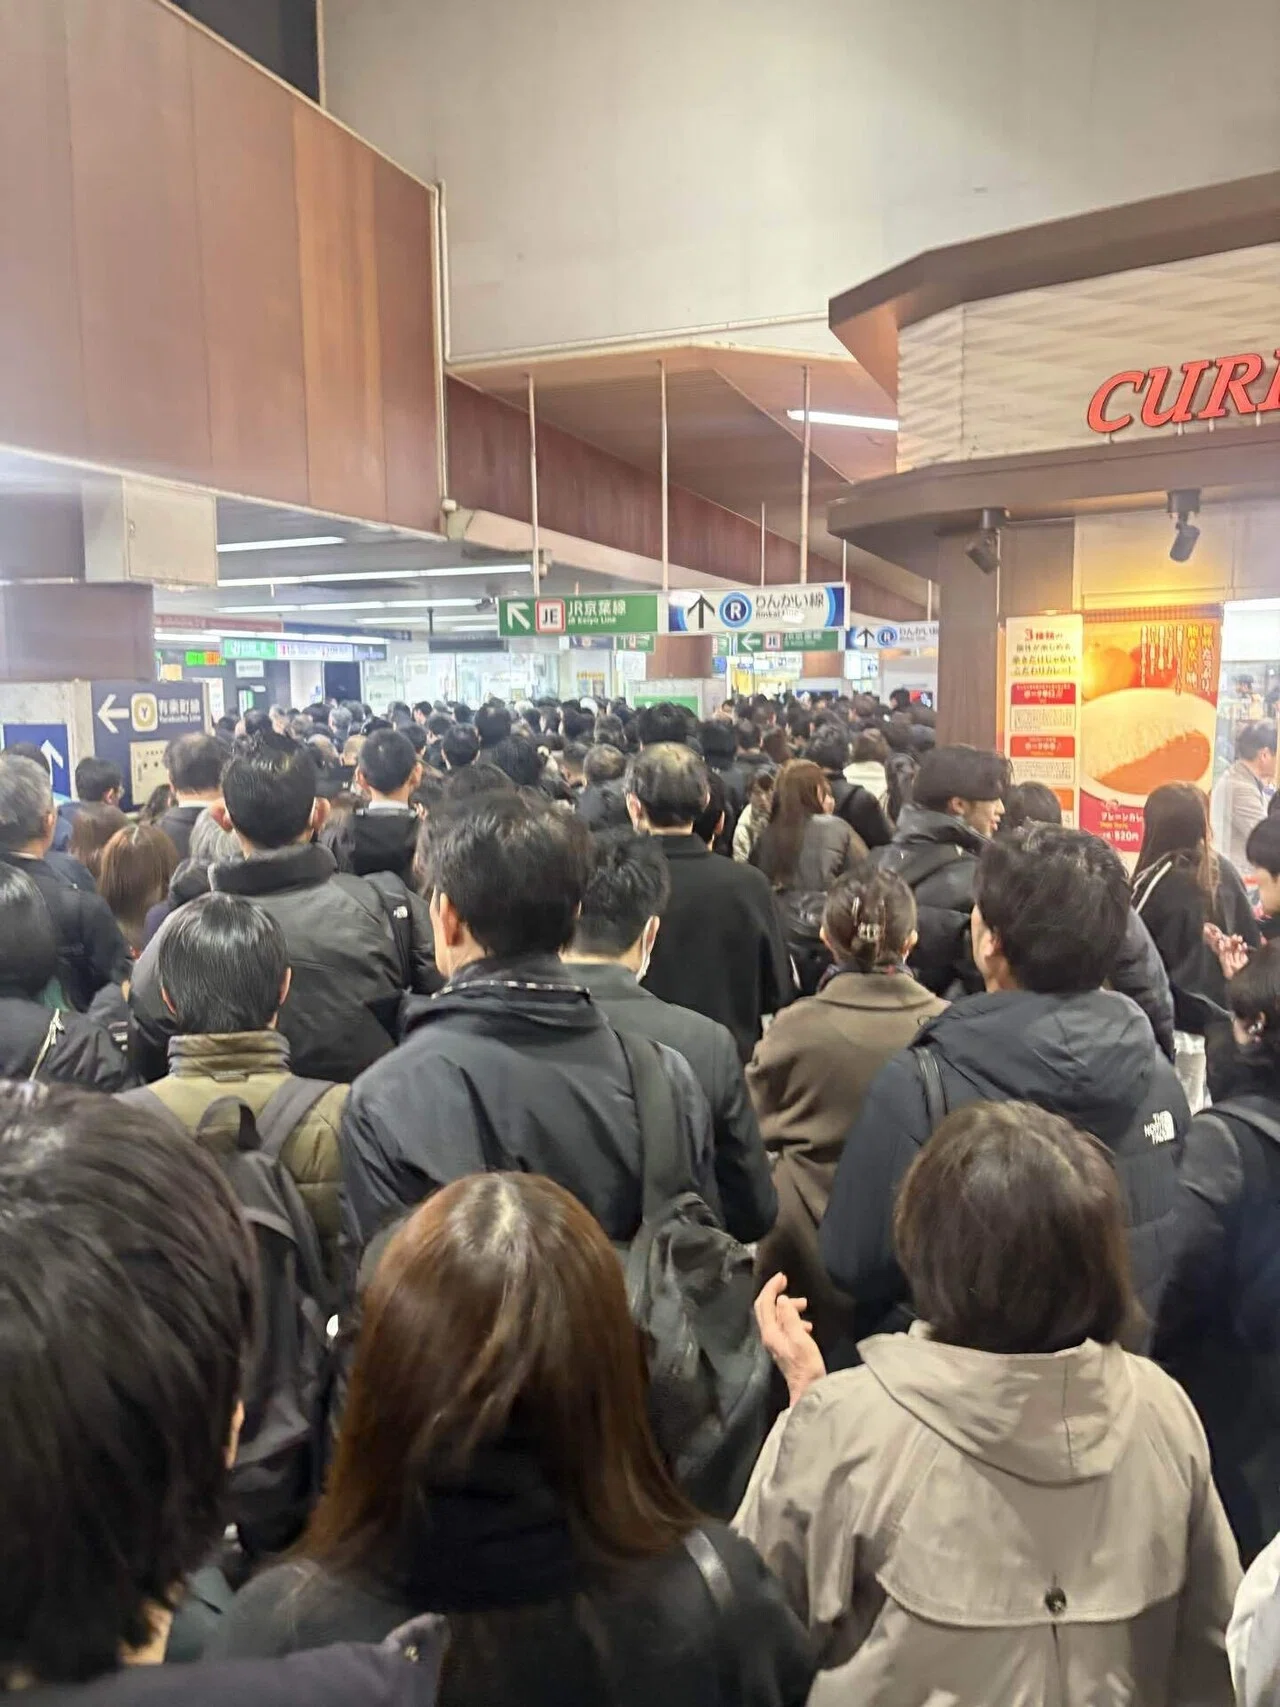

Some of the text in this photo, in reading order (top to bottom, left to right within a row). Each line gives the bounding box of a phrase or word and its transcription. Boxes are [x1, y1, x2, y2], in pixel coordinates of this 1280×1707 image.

[1087, 348, 1280, 433] CUR
[568, 599, 627, 616] JR京葉線
[755, 591, 824, 609] りんかい線
[542, 608, 559, 625] JE
[731, 603, 741, 619] R
